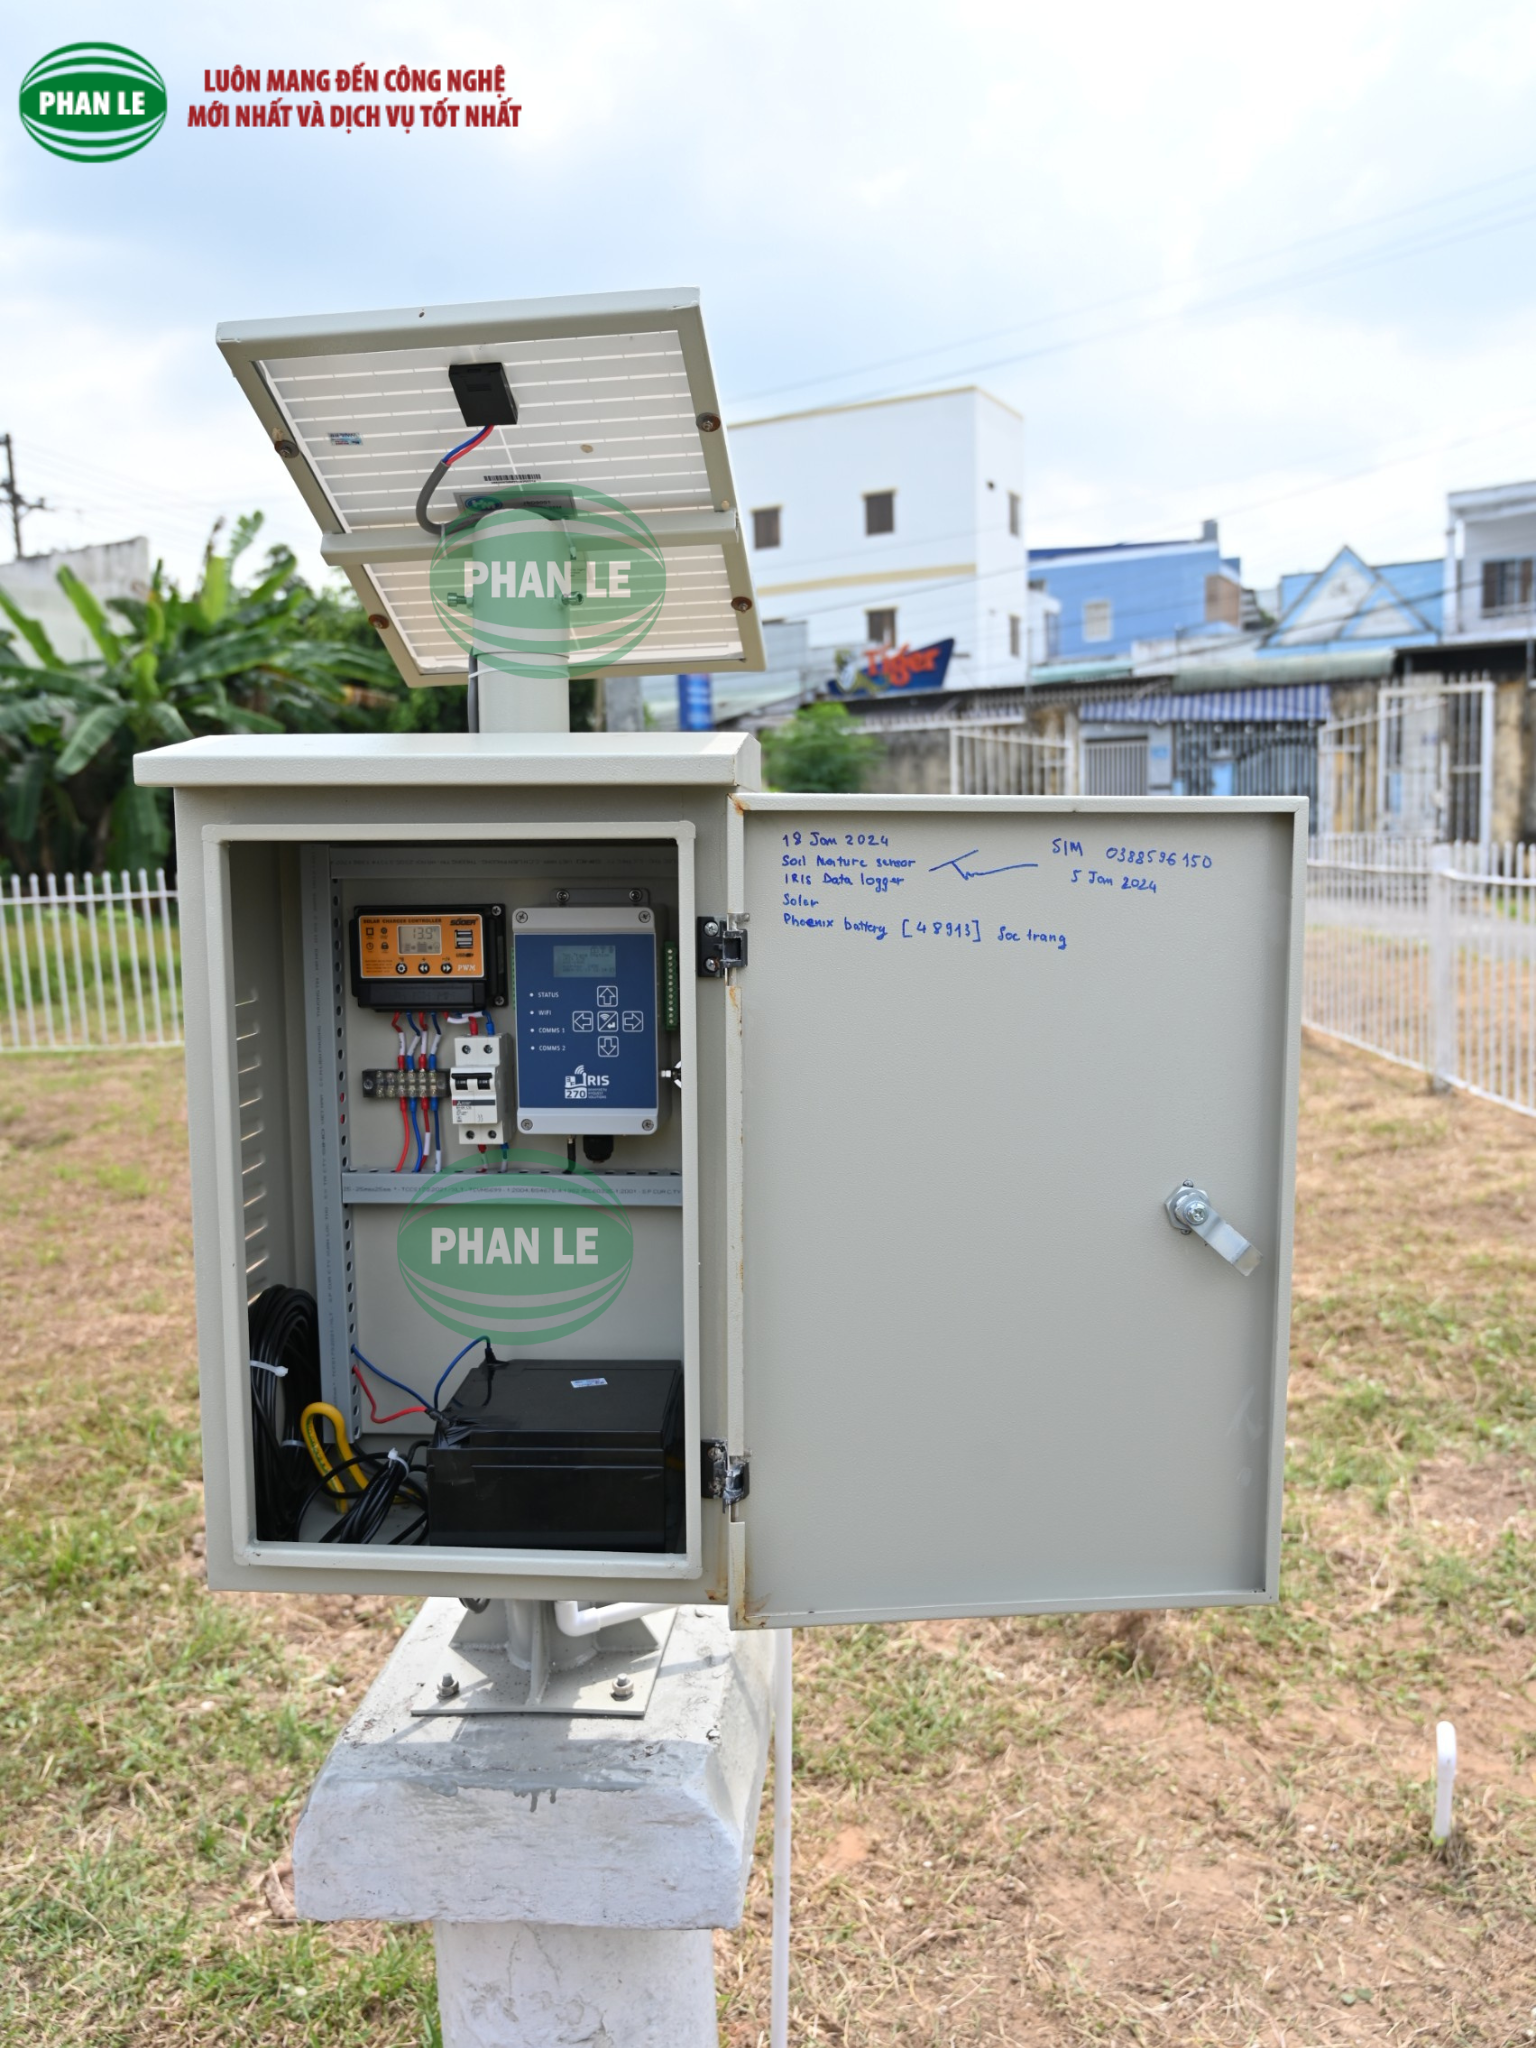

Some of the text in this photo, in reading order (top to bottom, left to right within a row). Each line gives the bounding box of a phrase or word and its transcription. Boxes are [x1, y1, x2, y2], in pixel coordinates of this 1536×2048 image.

[863, 641, 941, 687] Tiger
[782, 831, 802, 847] 18
[845, 834, 889, 846] 2024
[1052, 838, 1083, 856] SIM
[782, 854, 806, 867] Soil
[822, 872, 853, 886] Data
[861, 872, 905, 893] logger
[1071, 869, 1082, 883] 5
[1121, 876, 1157, 893] 2024
[783, 912, 834, 927] Phoenix
[844, 916, 888, 940] battery
[1026, 928, 1067, 950] trang
[566, 1090, 586, 1099] 270
